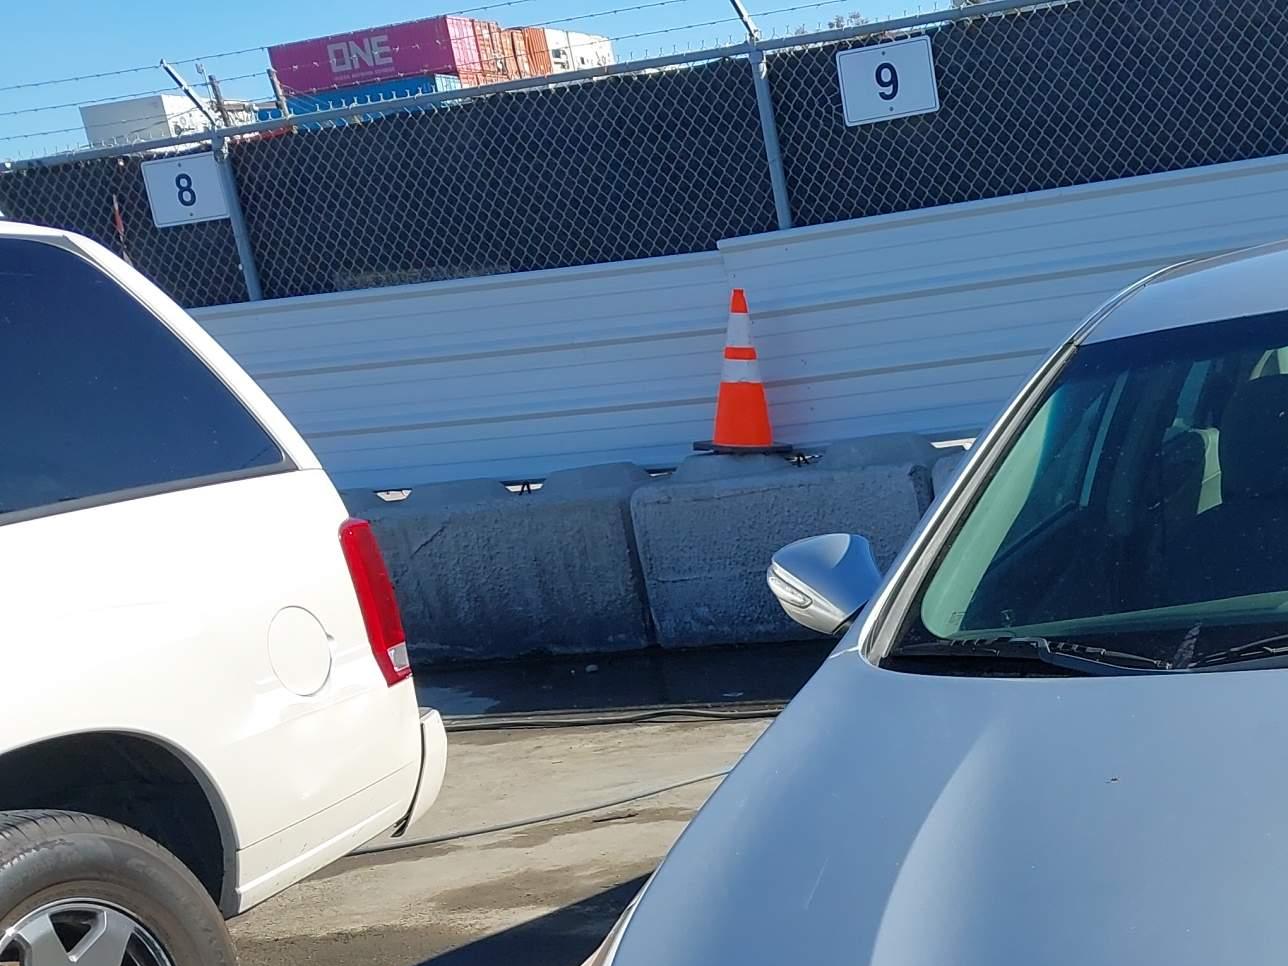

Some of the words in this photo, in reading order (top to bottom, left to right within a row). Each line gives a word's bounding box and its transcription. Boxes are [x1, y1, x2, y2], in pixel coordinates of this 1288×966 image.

[327, 35, 393, 73] ONE
[875, 62, 899, 101] 9
[175, 173, 197, 207] 8
